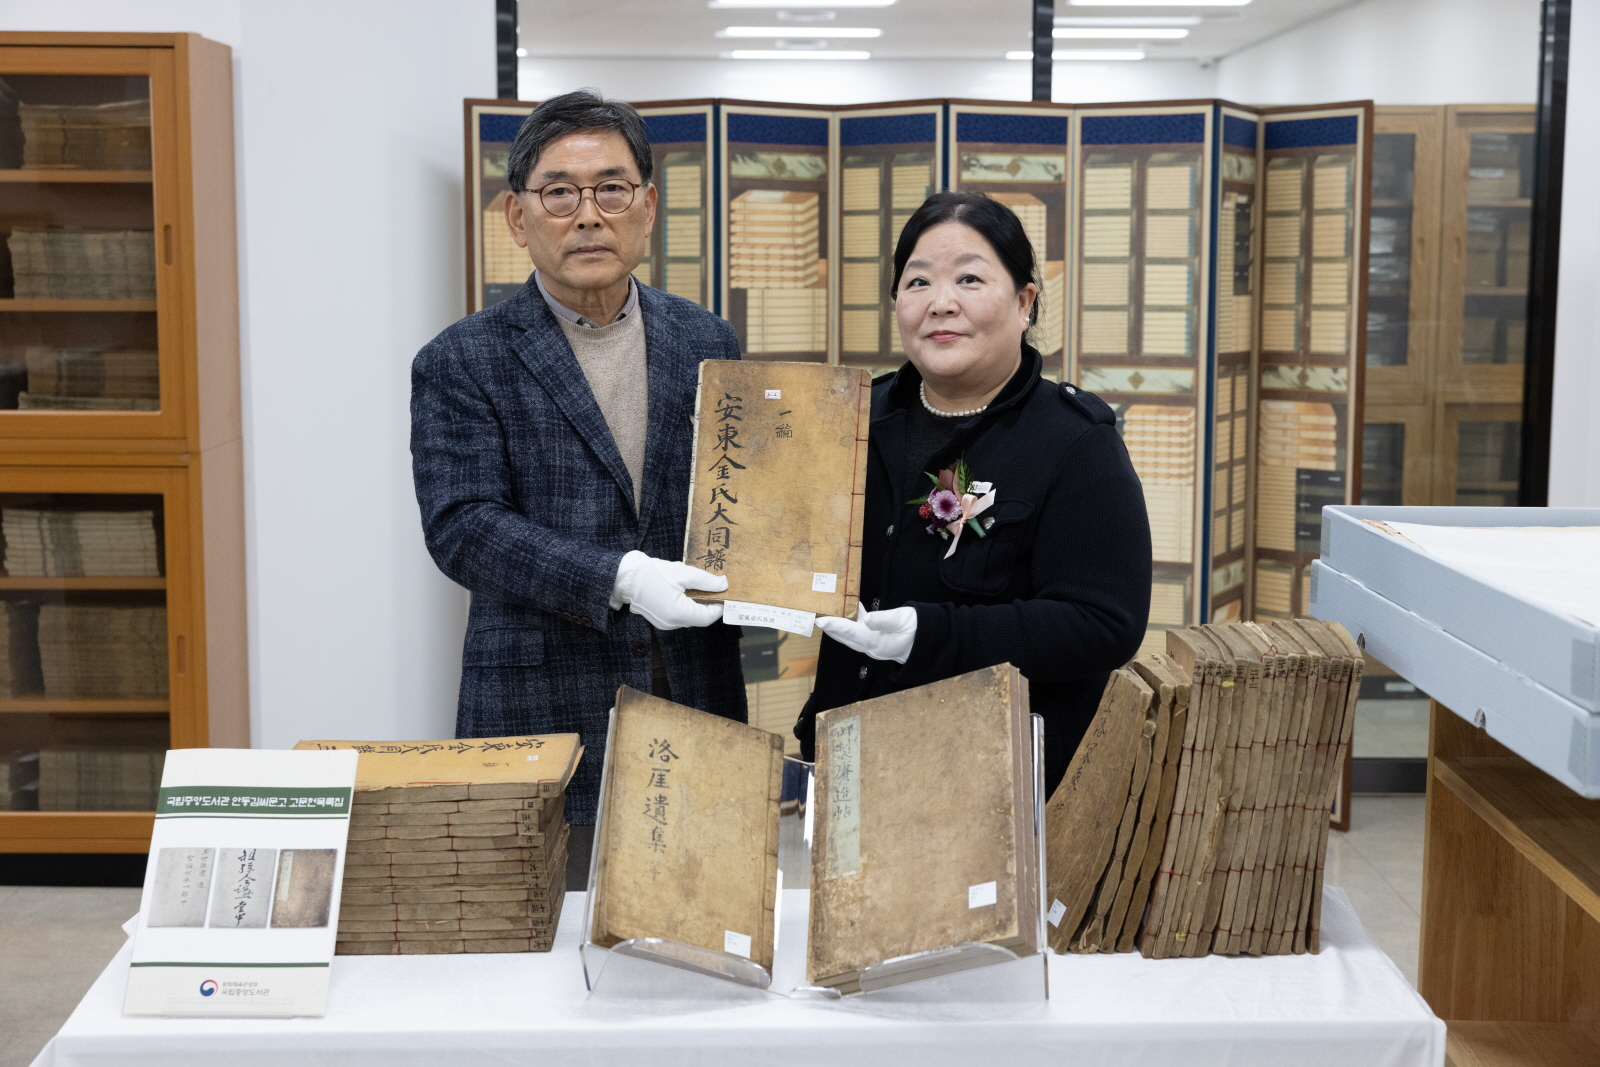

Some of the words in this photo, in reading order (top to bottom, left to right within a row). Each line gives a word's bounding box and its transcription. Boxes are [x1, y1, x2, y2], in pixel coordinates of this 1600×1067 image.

[696, 392, 747, 571] 安東金氏大同譜
[1248, 669, 1260, 689] 二十二
[167, 796, 230, 807] 국립중앙도서관
[231, 797, 287, 808] 안동김씨문고
[289, 797, 344, 808] 고문헌목록집
[221, 988, 270, 997] 국립중앙도서관
